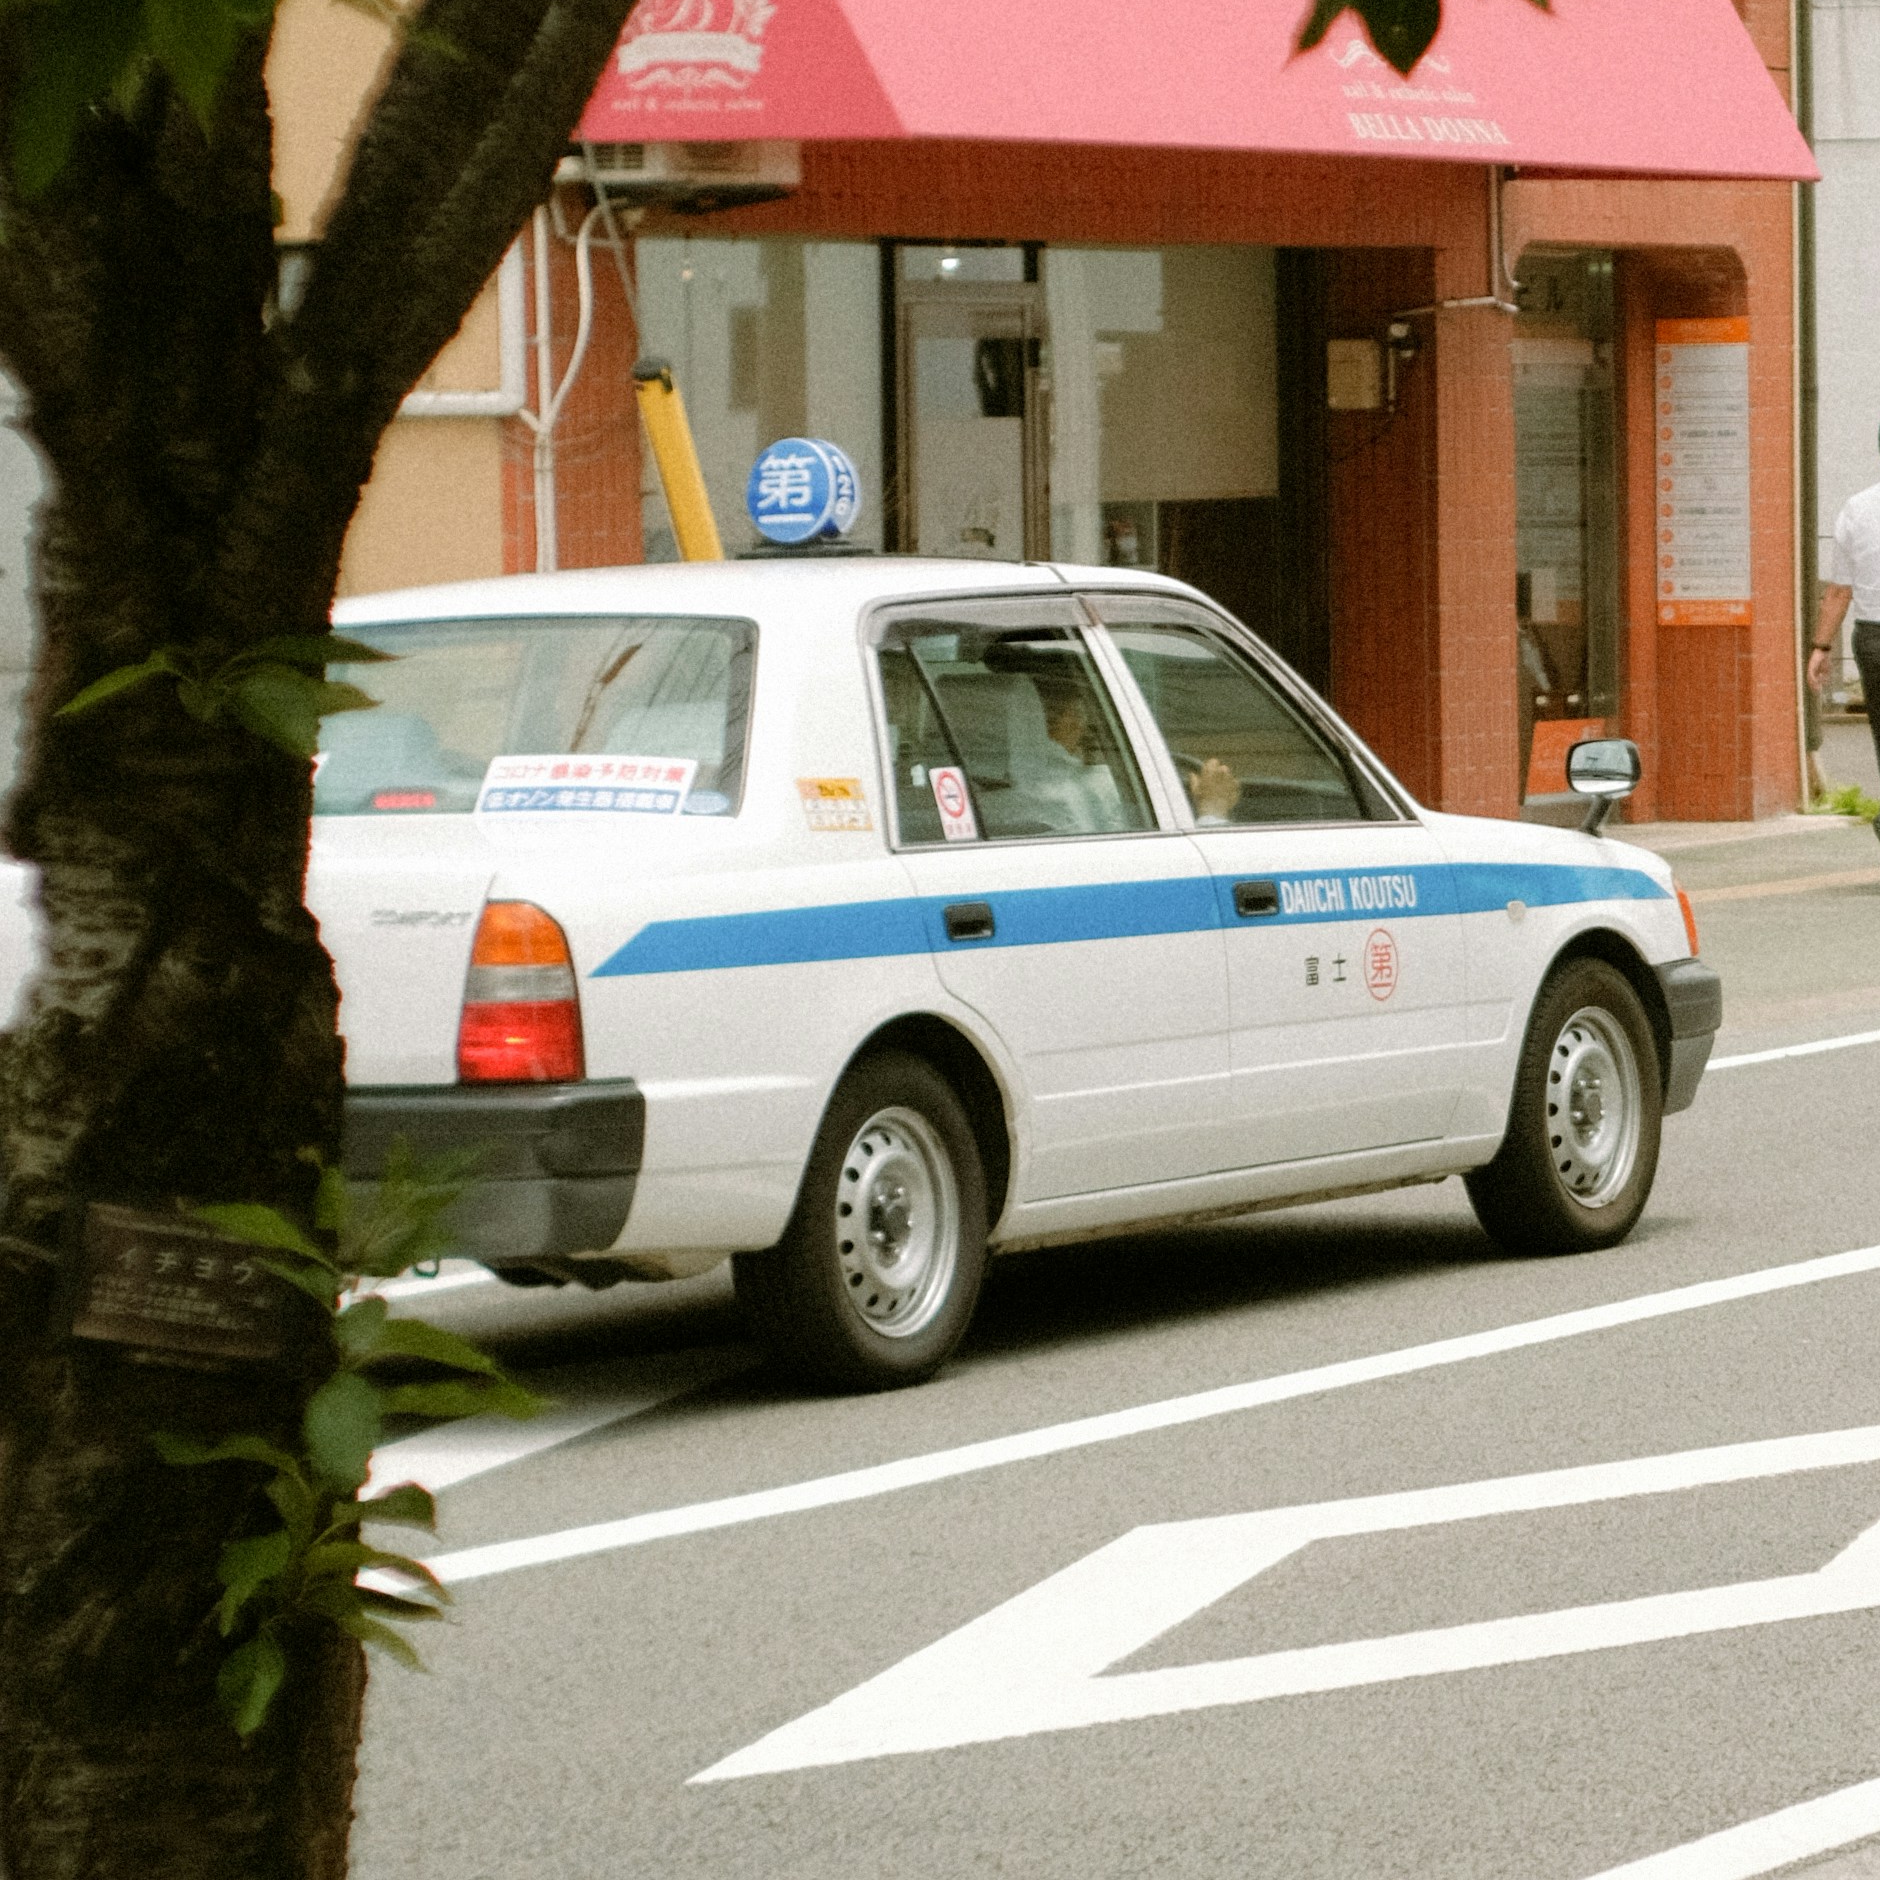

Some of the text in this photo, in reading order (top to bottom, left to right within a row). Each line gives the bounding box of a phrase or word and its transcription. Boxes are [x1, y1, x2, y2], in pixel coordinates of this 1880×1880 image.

[1348, 112, 1511, 144] BELLA DONNA
[757, 453, 818, 524] 第一
[1279, 874, 1417, 914] DAIICHI KOUTSU
[116, 1246, 256, 1285] イチョウ
